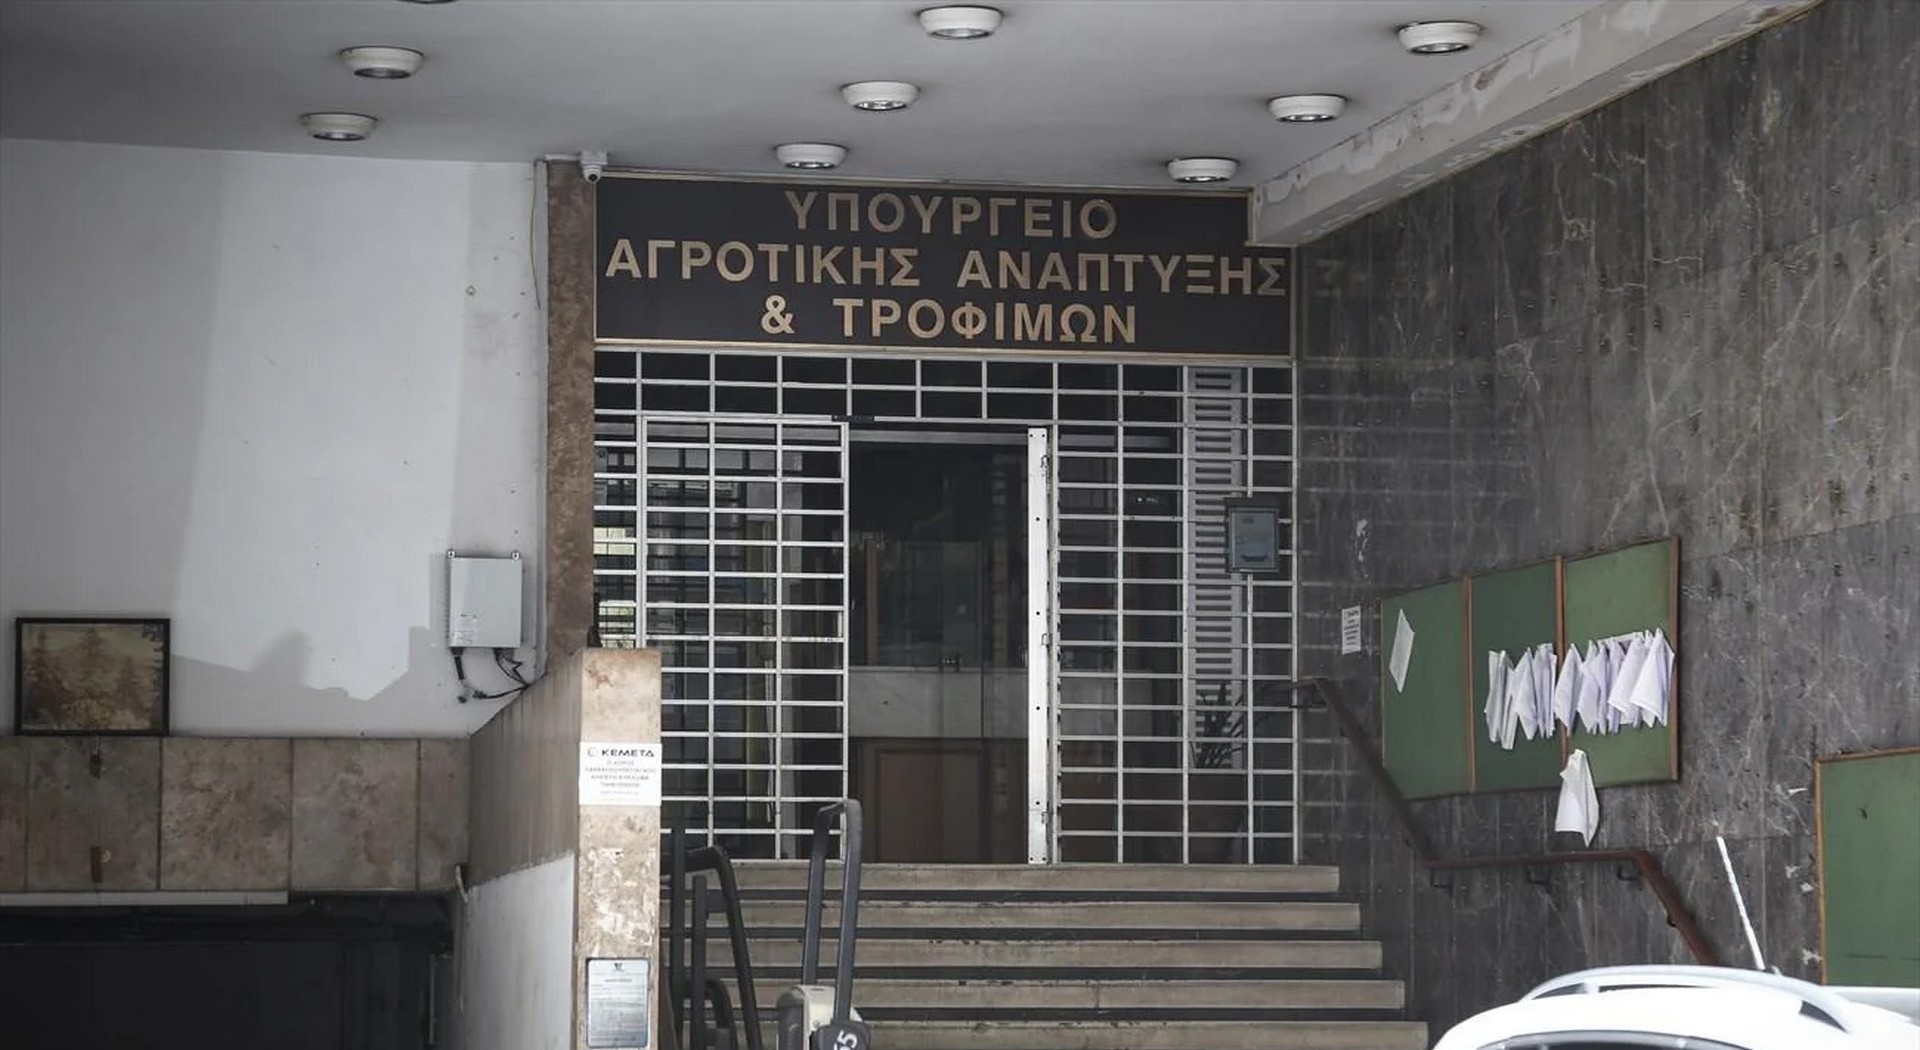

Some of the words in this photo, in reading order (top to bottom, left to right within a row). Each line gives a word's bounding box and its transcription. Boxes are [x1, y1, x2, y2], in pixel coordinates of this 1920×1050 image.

[785, 190, 1117, 239] ΥΠΟΥΡΓΕΙΟ
[605, 238, 920, 287] ΑΓΡΟΤΙΚΗΣ
[956, 250, 1286, 296] ΑΝΑΠΤΥΞΗΣ
[761, 294, 794, 334] &
[833, 298, 1135, 344] ΤΡΟΦΙΜΩΝ
